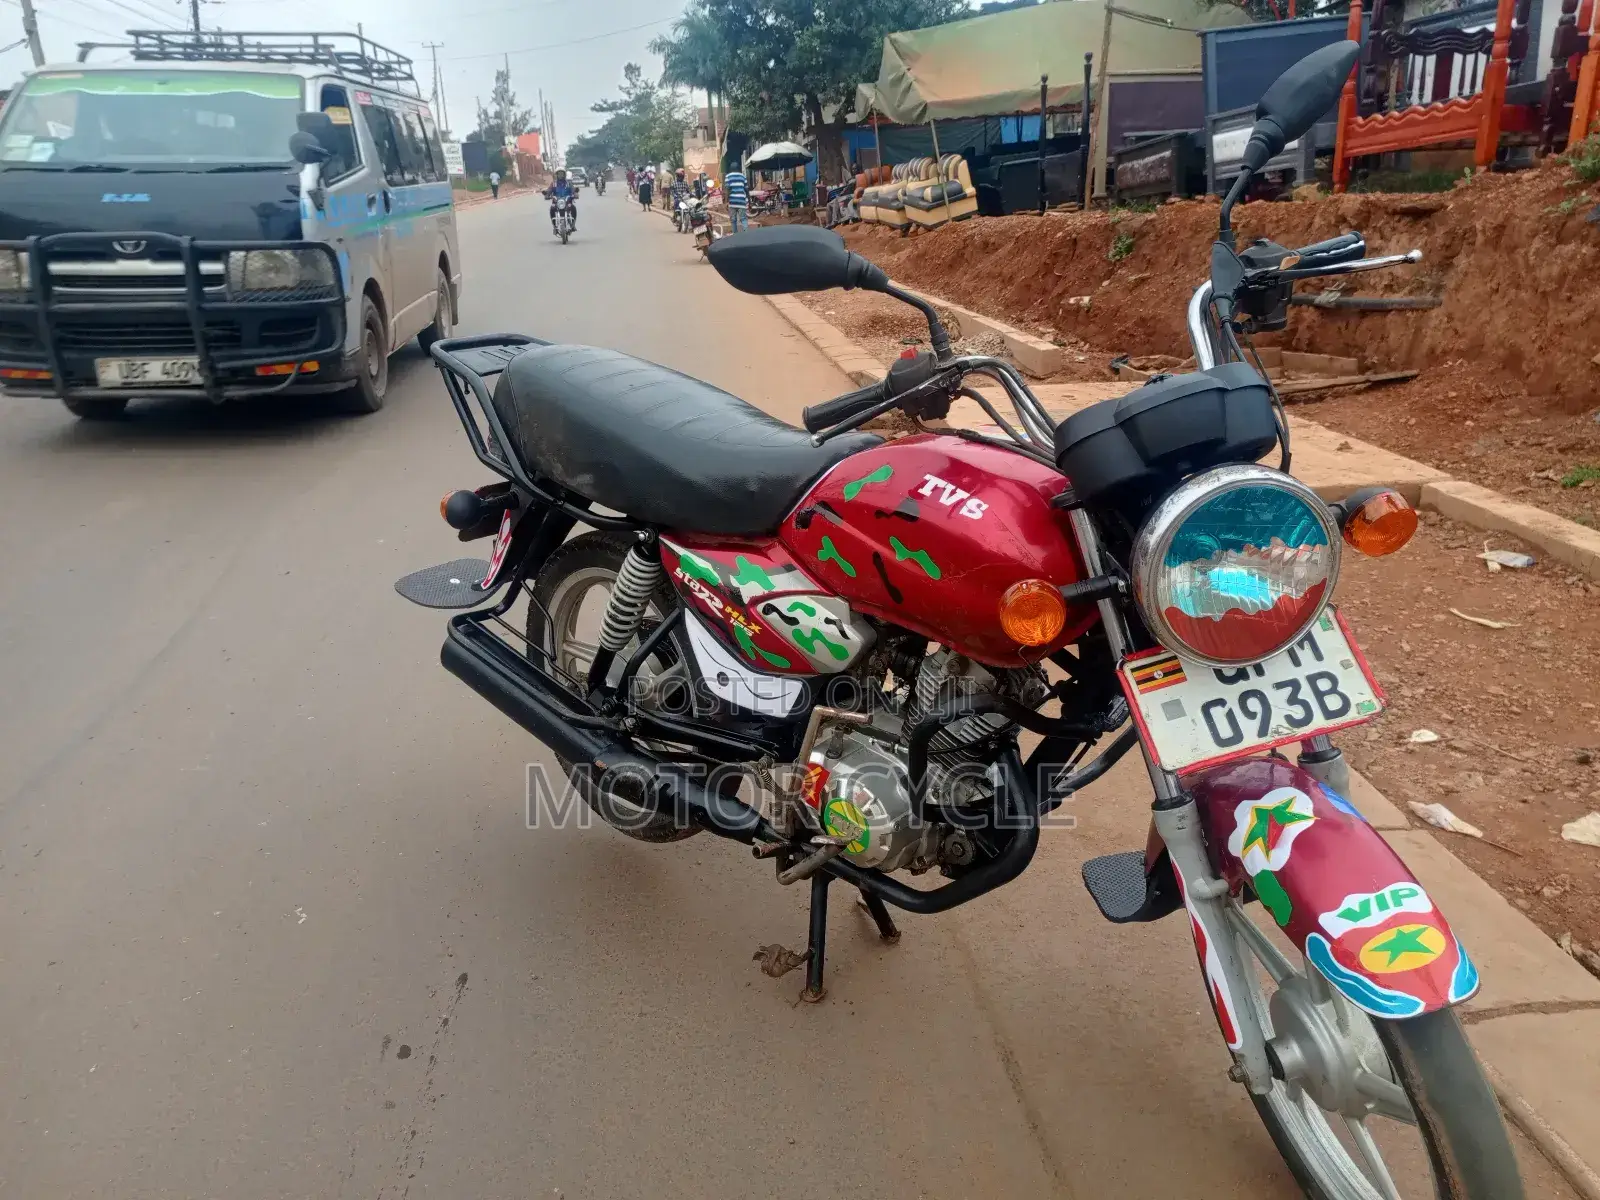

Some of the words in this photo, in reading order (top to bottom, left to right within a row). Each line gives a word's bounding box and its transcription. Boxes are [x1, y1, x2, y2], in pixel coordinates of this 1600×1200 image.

[917, 473, 989, 520] TVS
[724, 606, 762, 634] HLX
[1201, 671, 1351, 748] 093B
[1336, 887, 1419, 922] VIP
